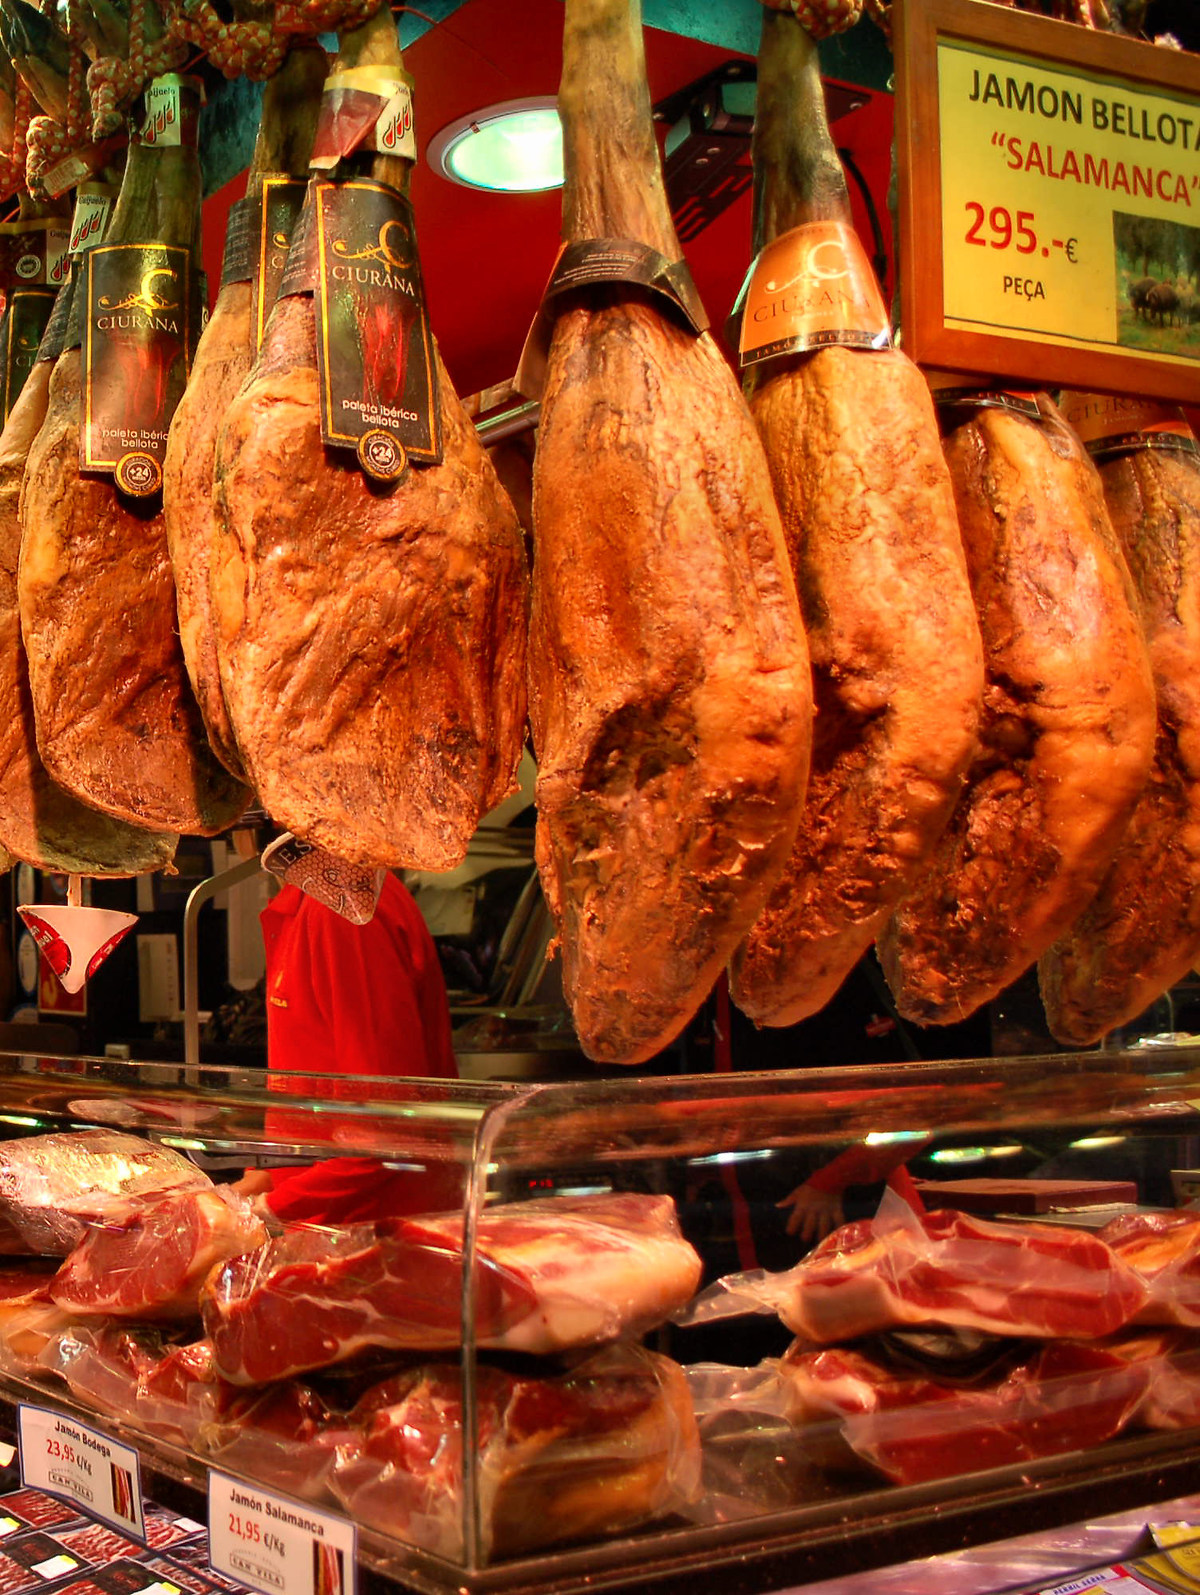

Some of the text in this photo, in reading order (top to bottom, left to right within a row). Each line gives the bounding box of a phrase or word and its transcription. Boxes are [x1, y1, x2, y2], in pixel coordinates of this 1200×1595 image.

[969, 69, 1083, 124] JAMON
[332, 265, 415, 297] CIURANA
[1002, 275, 1046, 301] PEÇA
[97, 316, 178, 334] CIURANA
[342, 399, 418, 421] paleta ibérica
[362, 412, 399, 428] bellota
[102, 429, 169, 441] paleta ibéric
[121, 438, 158, 449] bellota
[46, 1439, 75, 1463] 23,95
[54, 1421, 111, 1458] Jamón Bodega
[229, 1488, 324, 1536] Jamón Salamanca
[228, 1513, 286, 1557] 21,95 €/Kg
